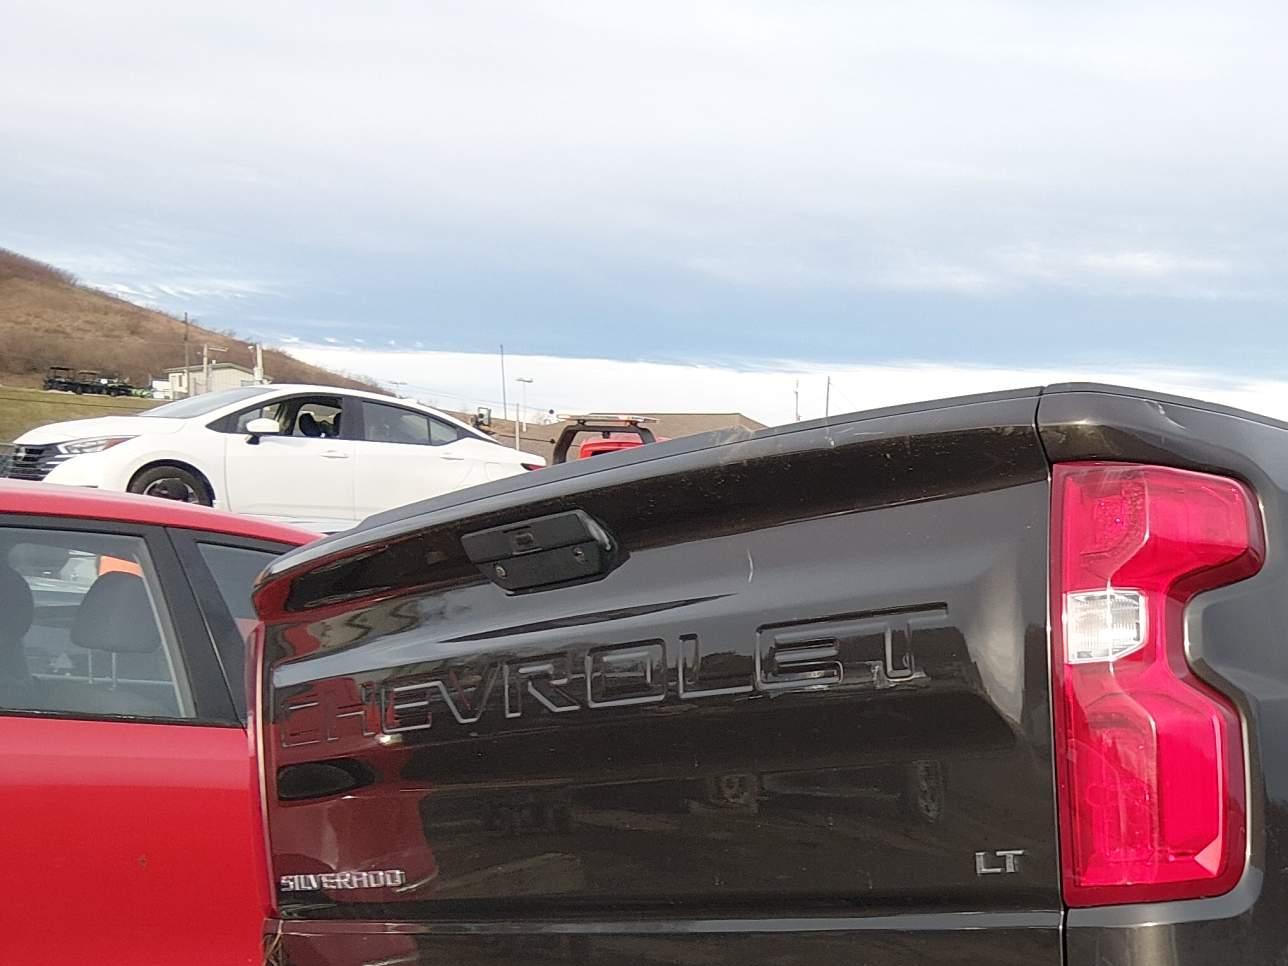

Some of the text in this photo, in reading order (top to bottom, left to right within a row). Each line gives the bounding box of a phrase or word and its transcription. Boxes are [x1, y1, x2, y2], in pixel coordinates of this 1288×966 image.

[277, 601, 950, 748] CHEVROLET
[975, 849, 1025, 876] LT
[279, 868, 407, 893] SILVERADO
